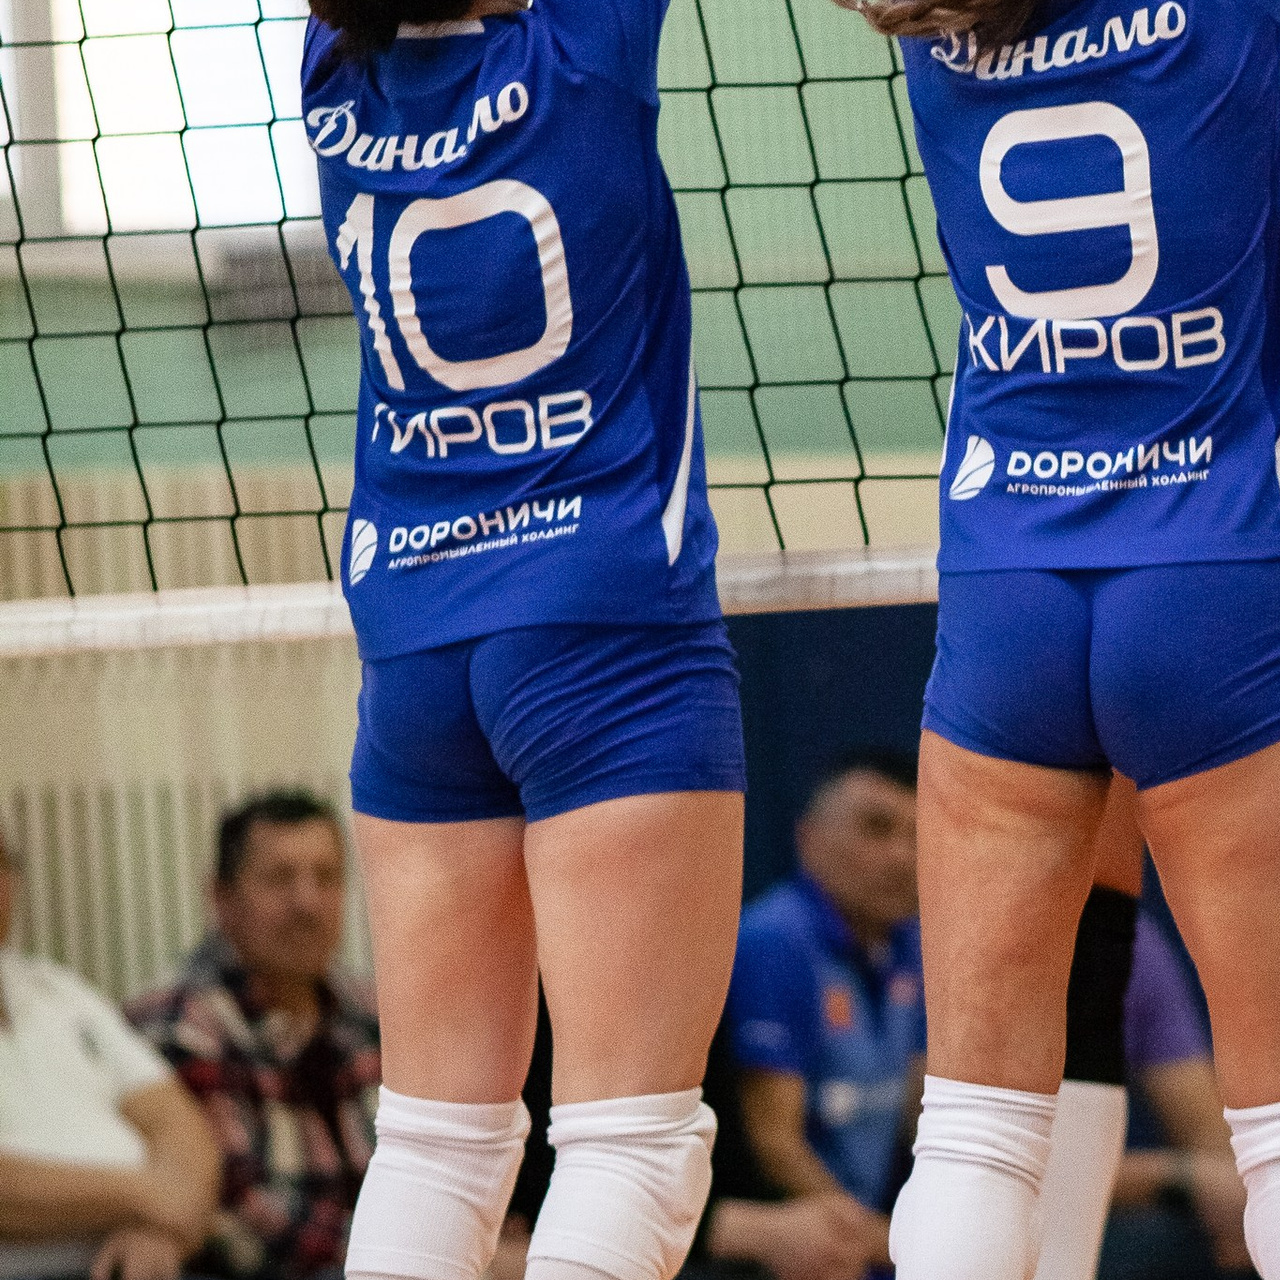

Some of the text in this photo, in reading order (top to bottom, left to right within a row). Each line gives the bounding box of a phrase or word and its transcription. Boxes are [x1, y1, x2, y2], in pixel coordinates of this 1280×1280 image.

[335, 178, 574, 392] 10
[979, 100, 1160, 321] 9
[964, 306, 1227, 374] КИРОВ
